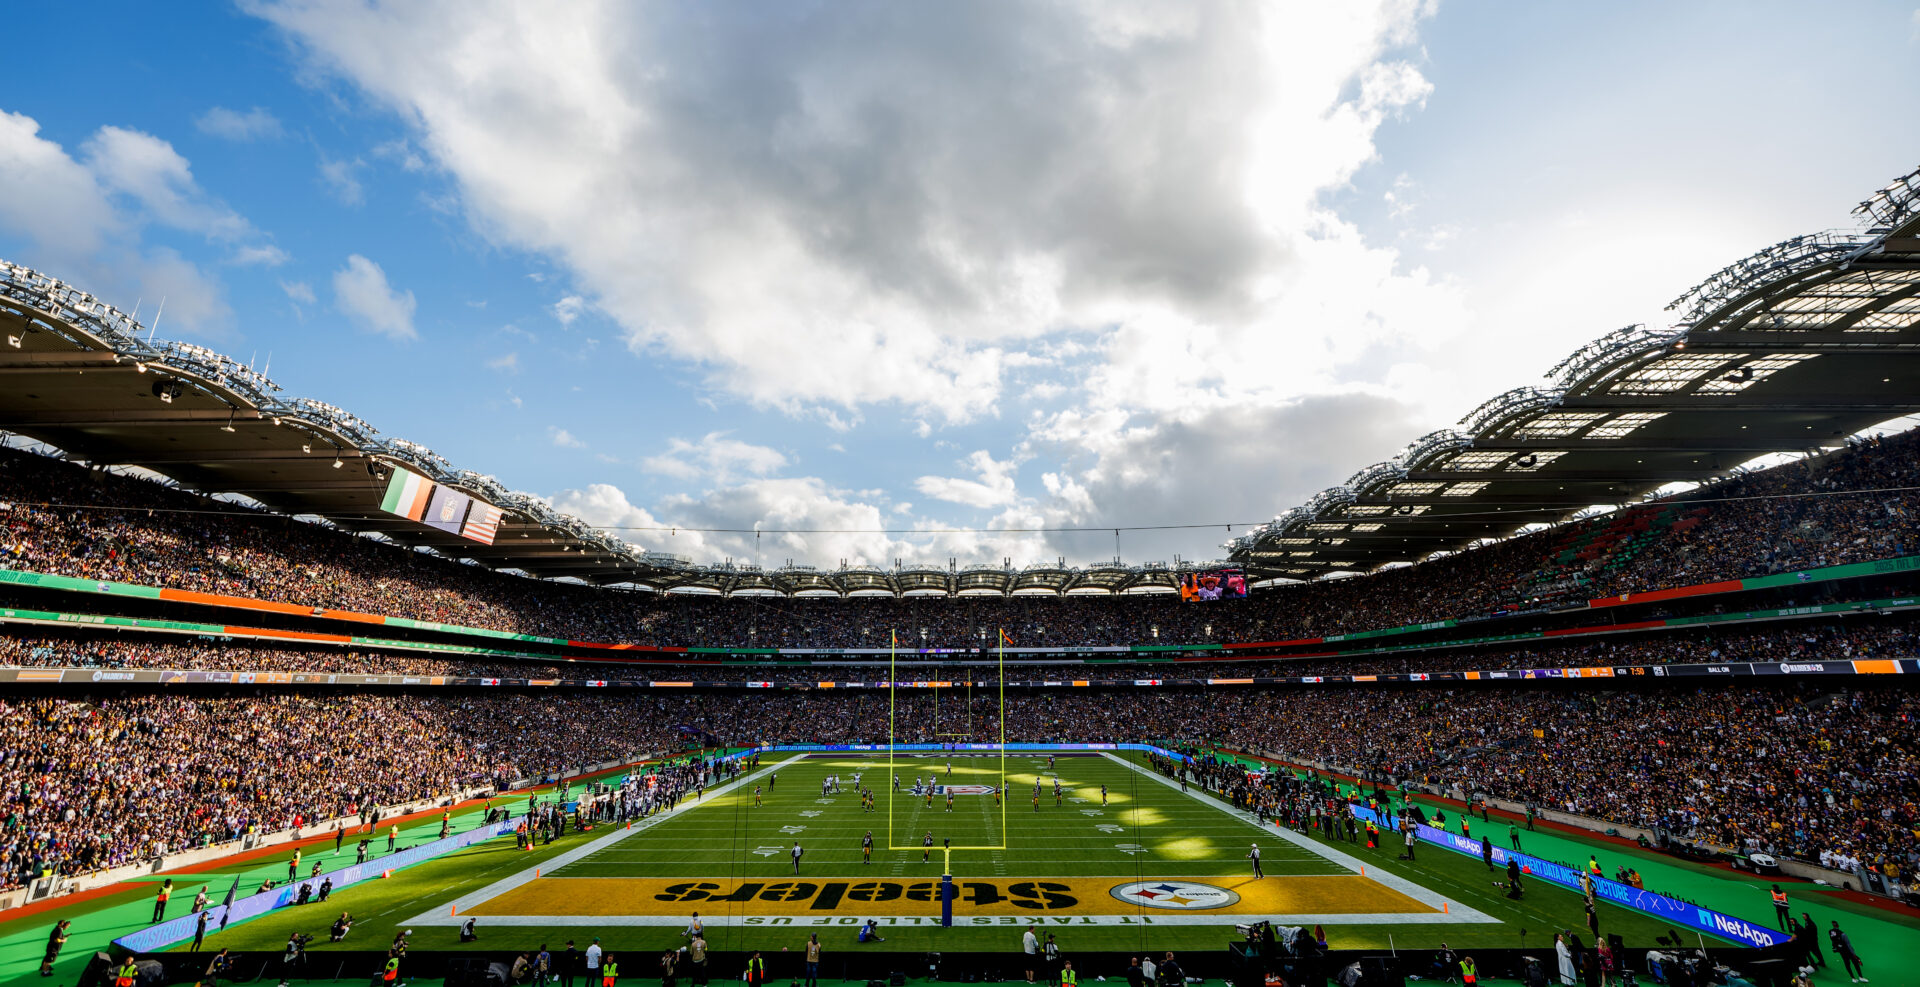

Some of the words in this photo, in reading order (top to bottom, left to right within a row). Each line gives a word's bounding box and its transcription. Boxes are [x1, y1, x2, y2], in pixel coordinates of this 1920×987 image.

[1896, 559, 1911, 569] NFL
[0, 570, 19, 582] BLIN
[18, 573, 42, 584] GAME
[1455, 837, 1481, 855] NetApp
[1542, 861, 1562, 882] DATA
[654, 882, 1079, 910] Steelers
[743, 917, 793, 925] US
[812, 917, 859, 925] OF
[880, 917, 943, 925] ALL
[972, 916, 1098, 925] TAKES
[1120, 916, 1153, 924] IT
[1714, 914, 1774, 947] NetApp
